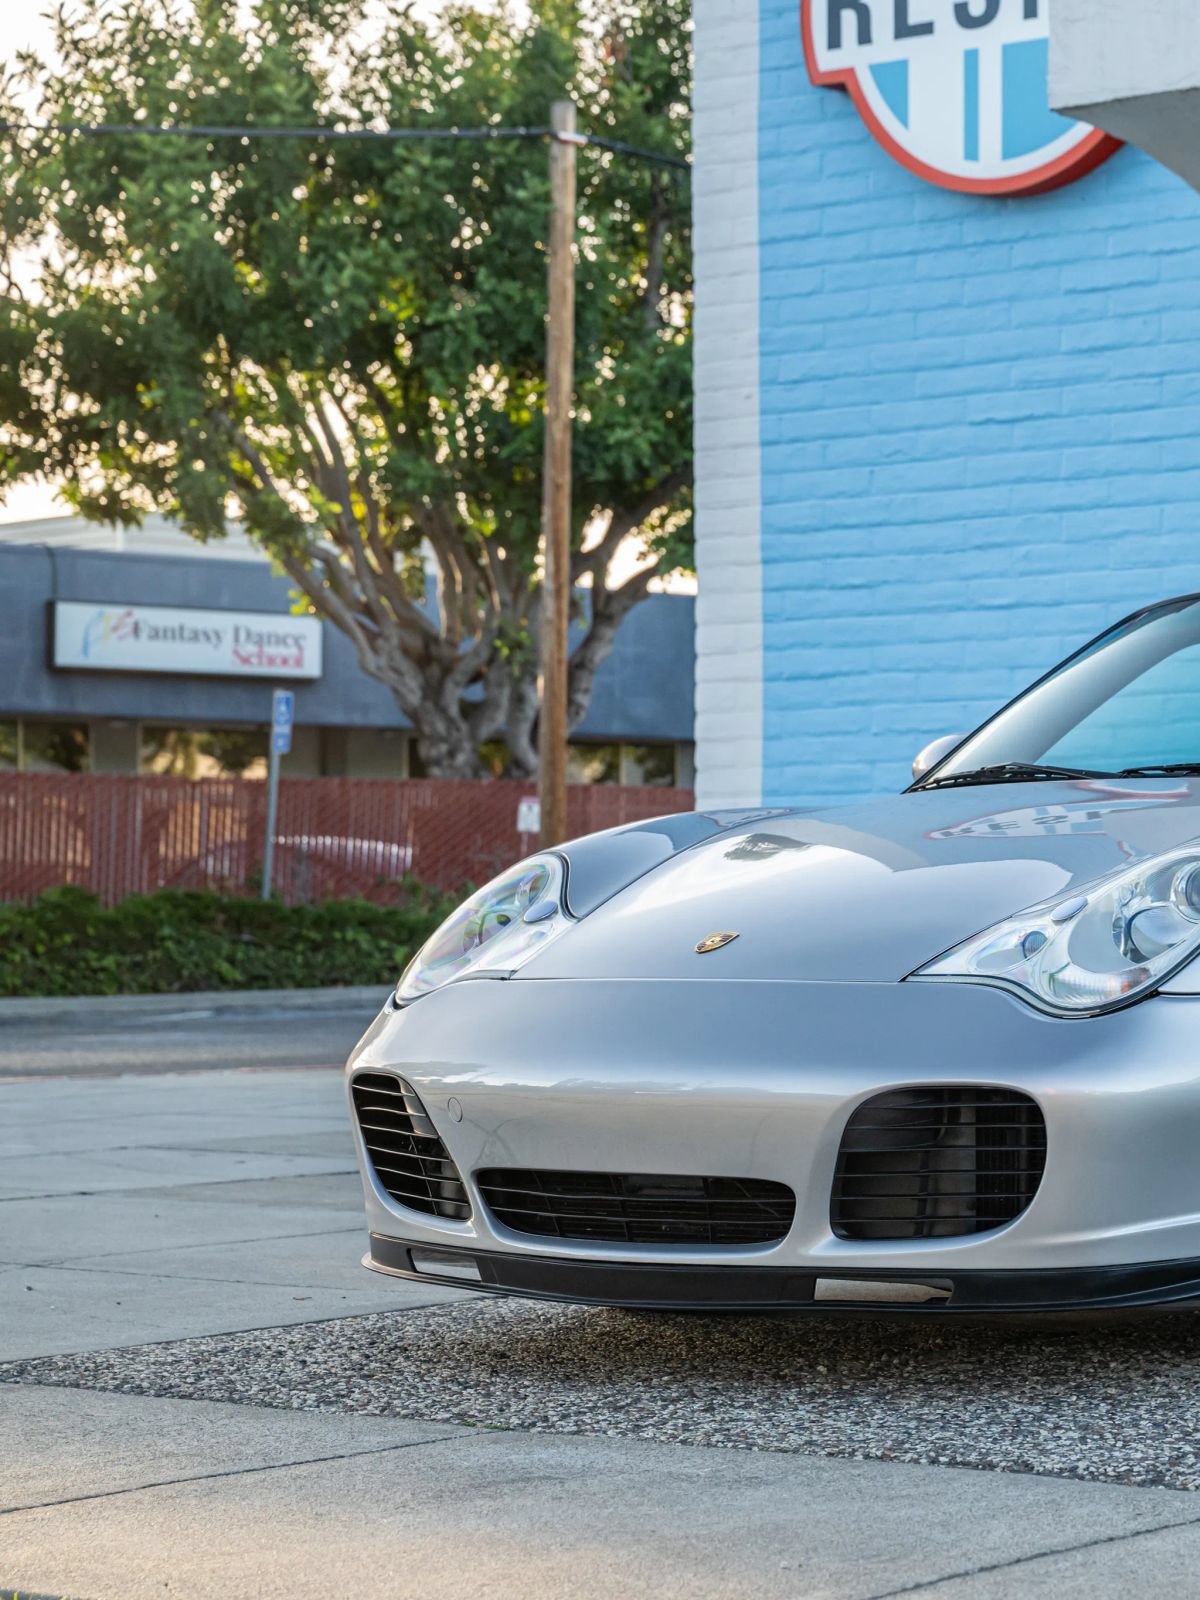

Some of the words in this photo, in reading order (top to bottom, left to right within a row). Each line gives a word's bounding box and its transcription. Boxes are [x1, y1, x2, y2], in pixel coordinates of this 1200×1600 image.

[133, 619, 224, 648] Fantasy
[232, 623, 306, 648] Dance
[232, 645, 305, 669] School
